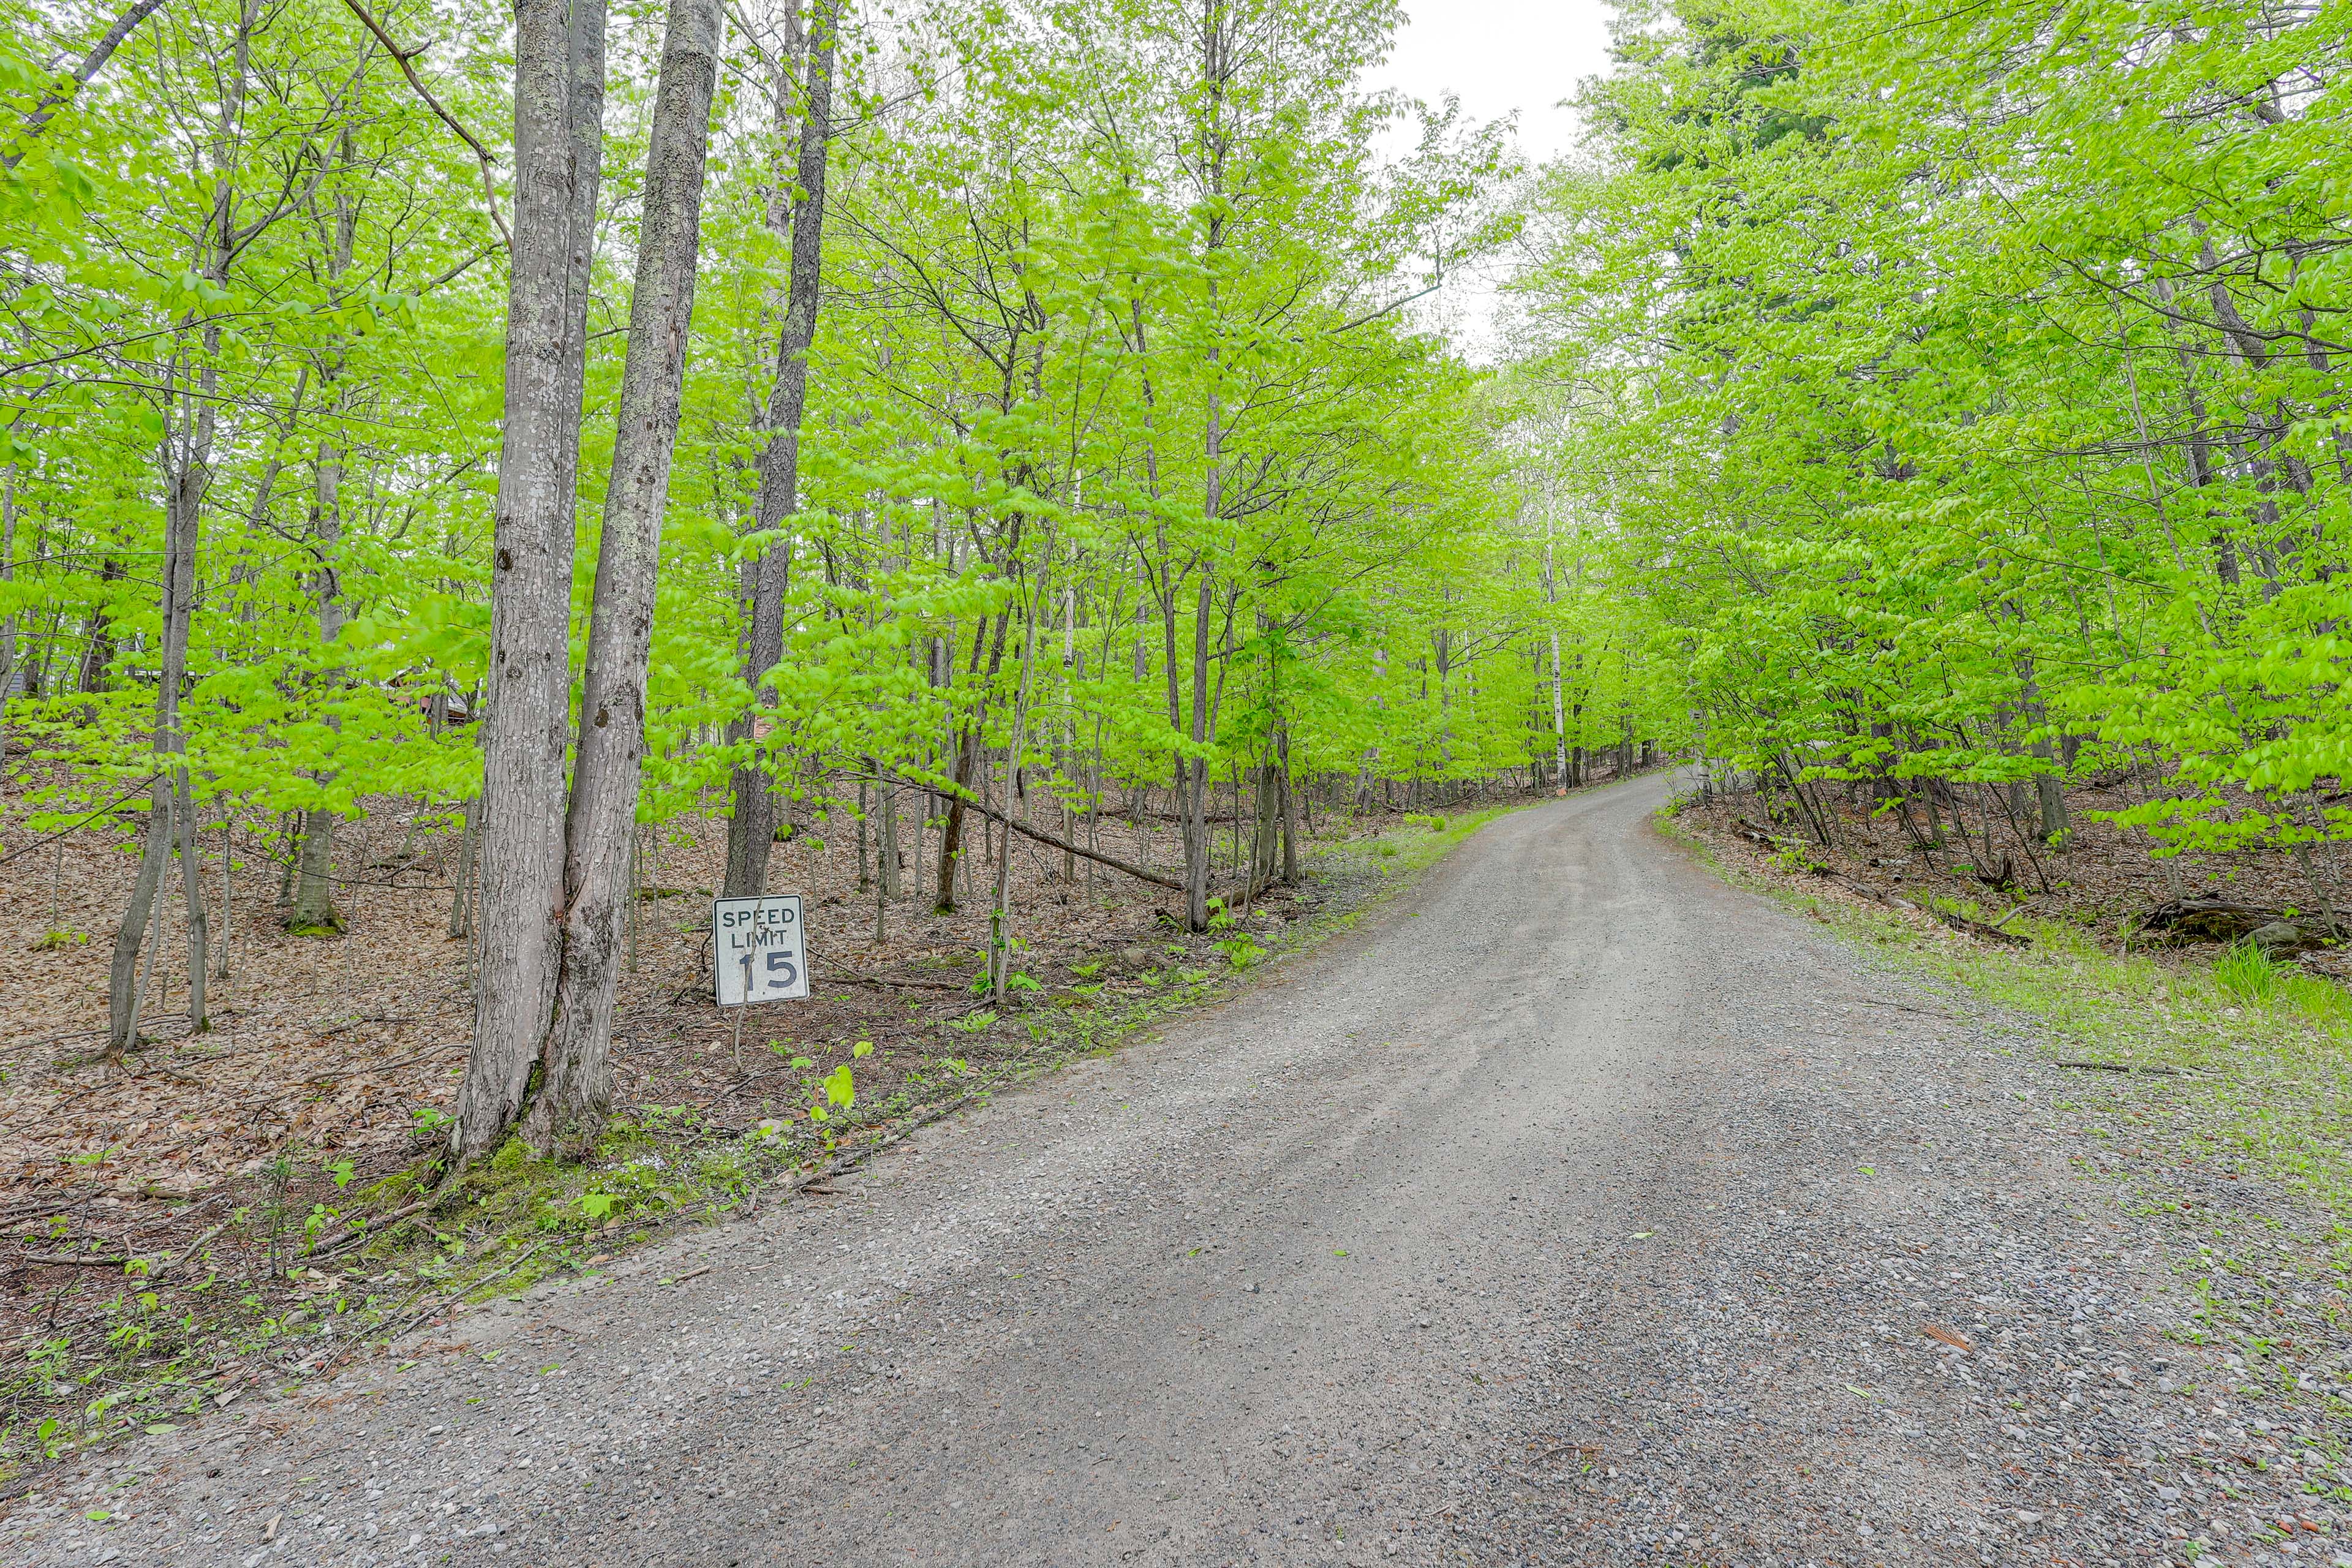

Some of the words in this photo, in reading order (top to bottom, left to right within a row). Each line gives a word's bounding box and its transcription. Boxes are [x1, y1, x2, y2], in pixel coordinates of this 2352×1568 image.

[723, 908, 794, 927] SPEED
[731, 930, 787, 948] LIMIT
[739, 951, 797, 991] 15
